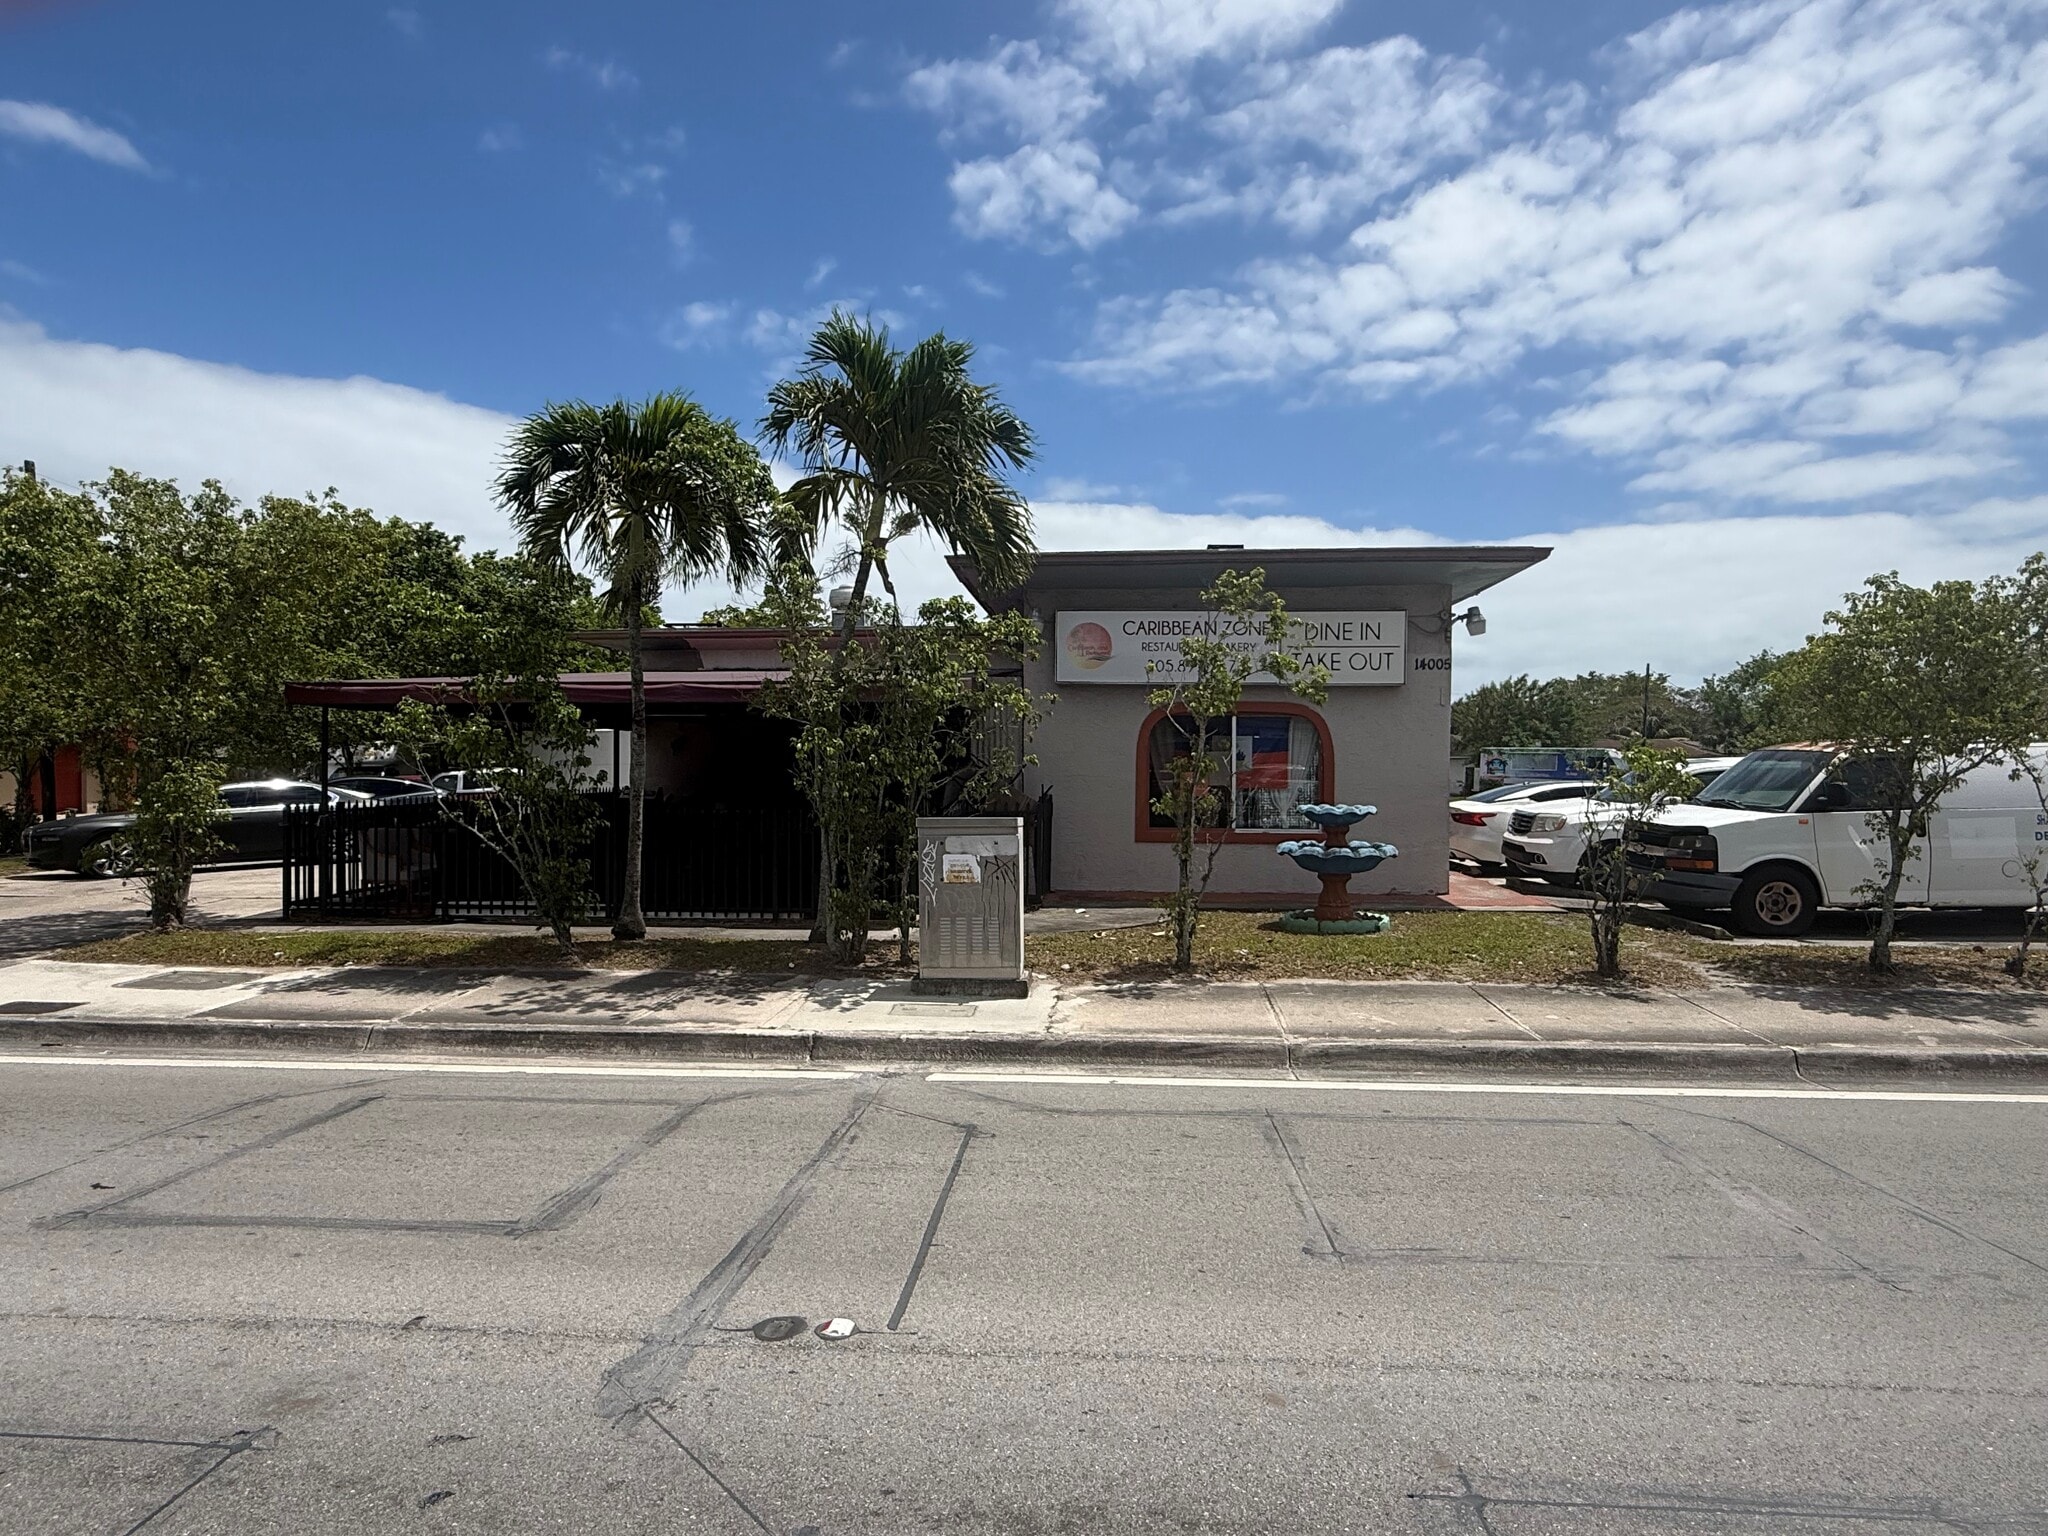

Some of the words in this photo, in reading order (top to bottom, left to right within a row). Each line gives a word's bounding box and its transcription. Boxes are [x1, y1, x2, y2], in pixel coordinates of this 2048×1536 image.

[1122, 620, 1217, 636] CARIBBEAN
[1222, 620, 1271, 636] ZONE
[1304, 622, 1353, 641] DINE
[1360, 622, 1381, 641] IN
[1291, 652, 1341, 671] TAKE
[1348, 652, 1394, 671] OUT
[1414, 657, 1451, 671] 14005
